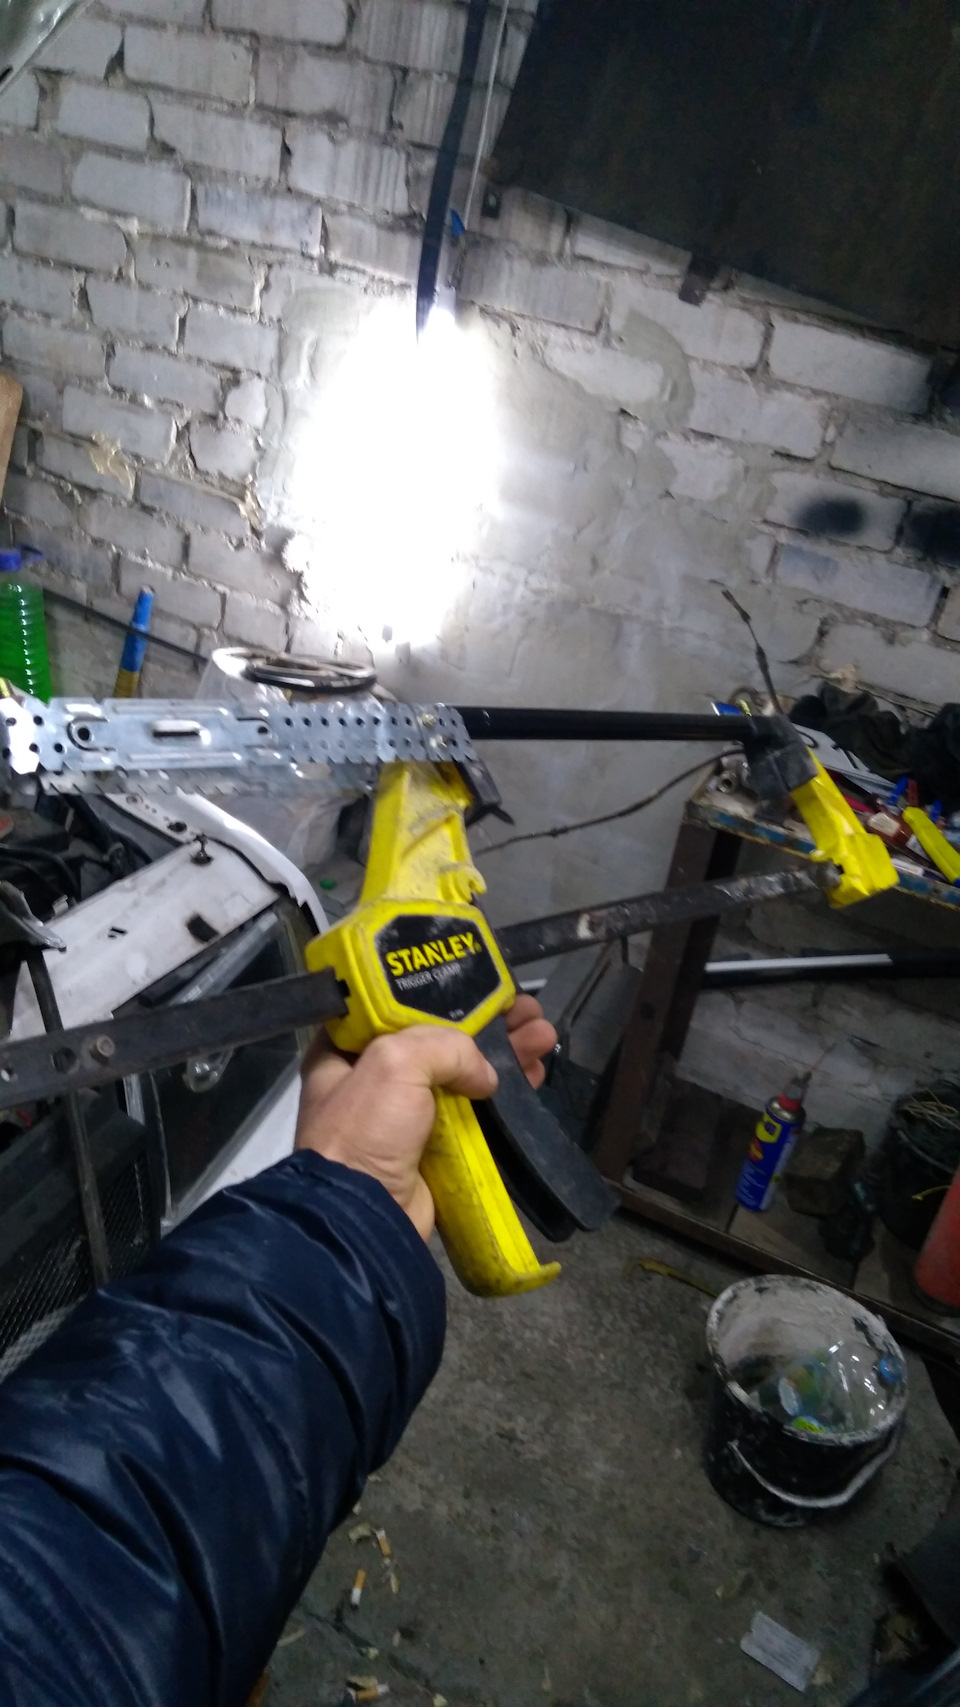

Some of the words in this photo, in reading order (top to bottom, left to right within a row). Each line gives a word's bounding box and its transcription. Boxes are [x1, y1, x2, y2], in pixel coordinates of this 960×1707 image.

[386, 932, 476, 976] STANLEY
[395, 970, 434, 991] TRIGGER
[433, 962, 462, 982] CLAMP
